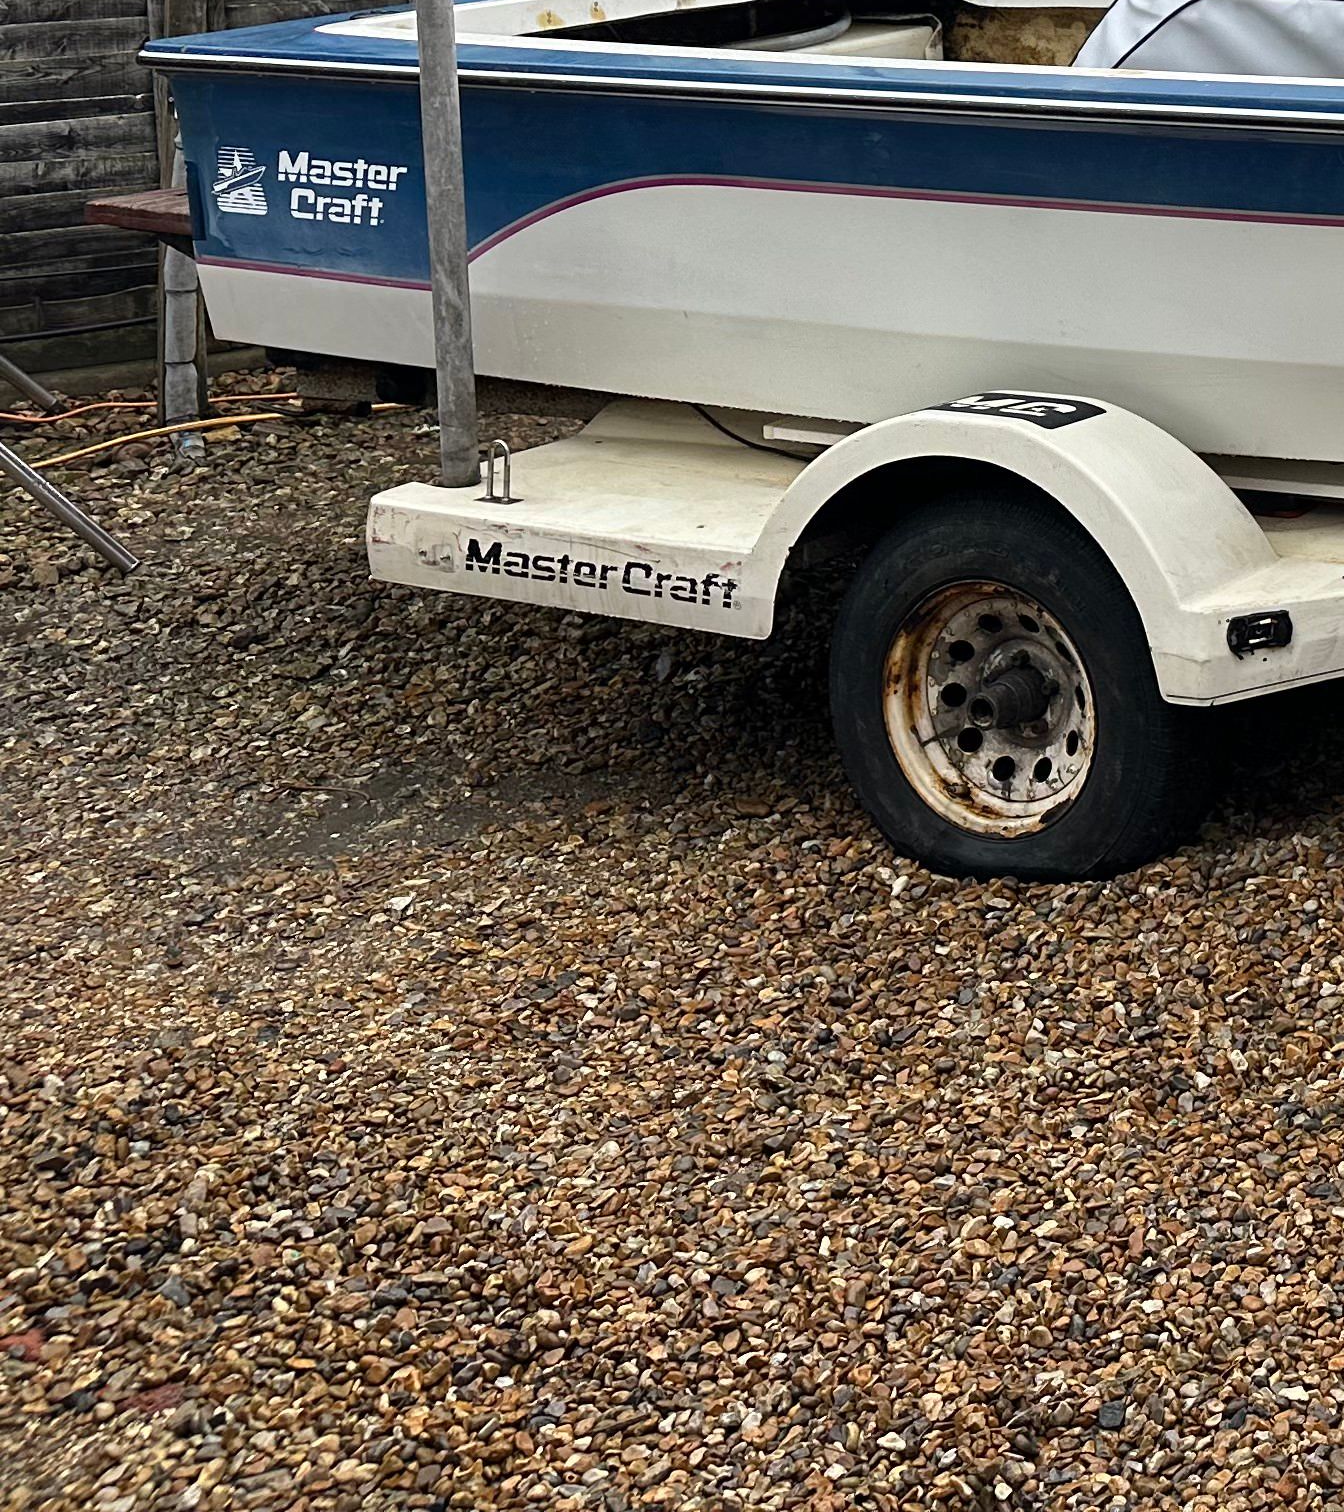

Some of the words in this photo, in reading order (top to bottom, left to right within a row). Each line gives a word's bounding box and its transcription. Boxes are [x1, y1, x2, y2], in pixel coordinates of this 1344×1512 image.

[277, 149, 408, 191] Master
[290, 187, 384, 226] Craft
[465, 538, 738, 609] MasterCraft
